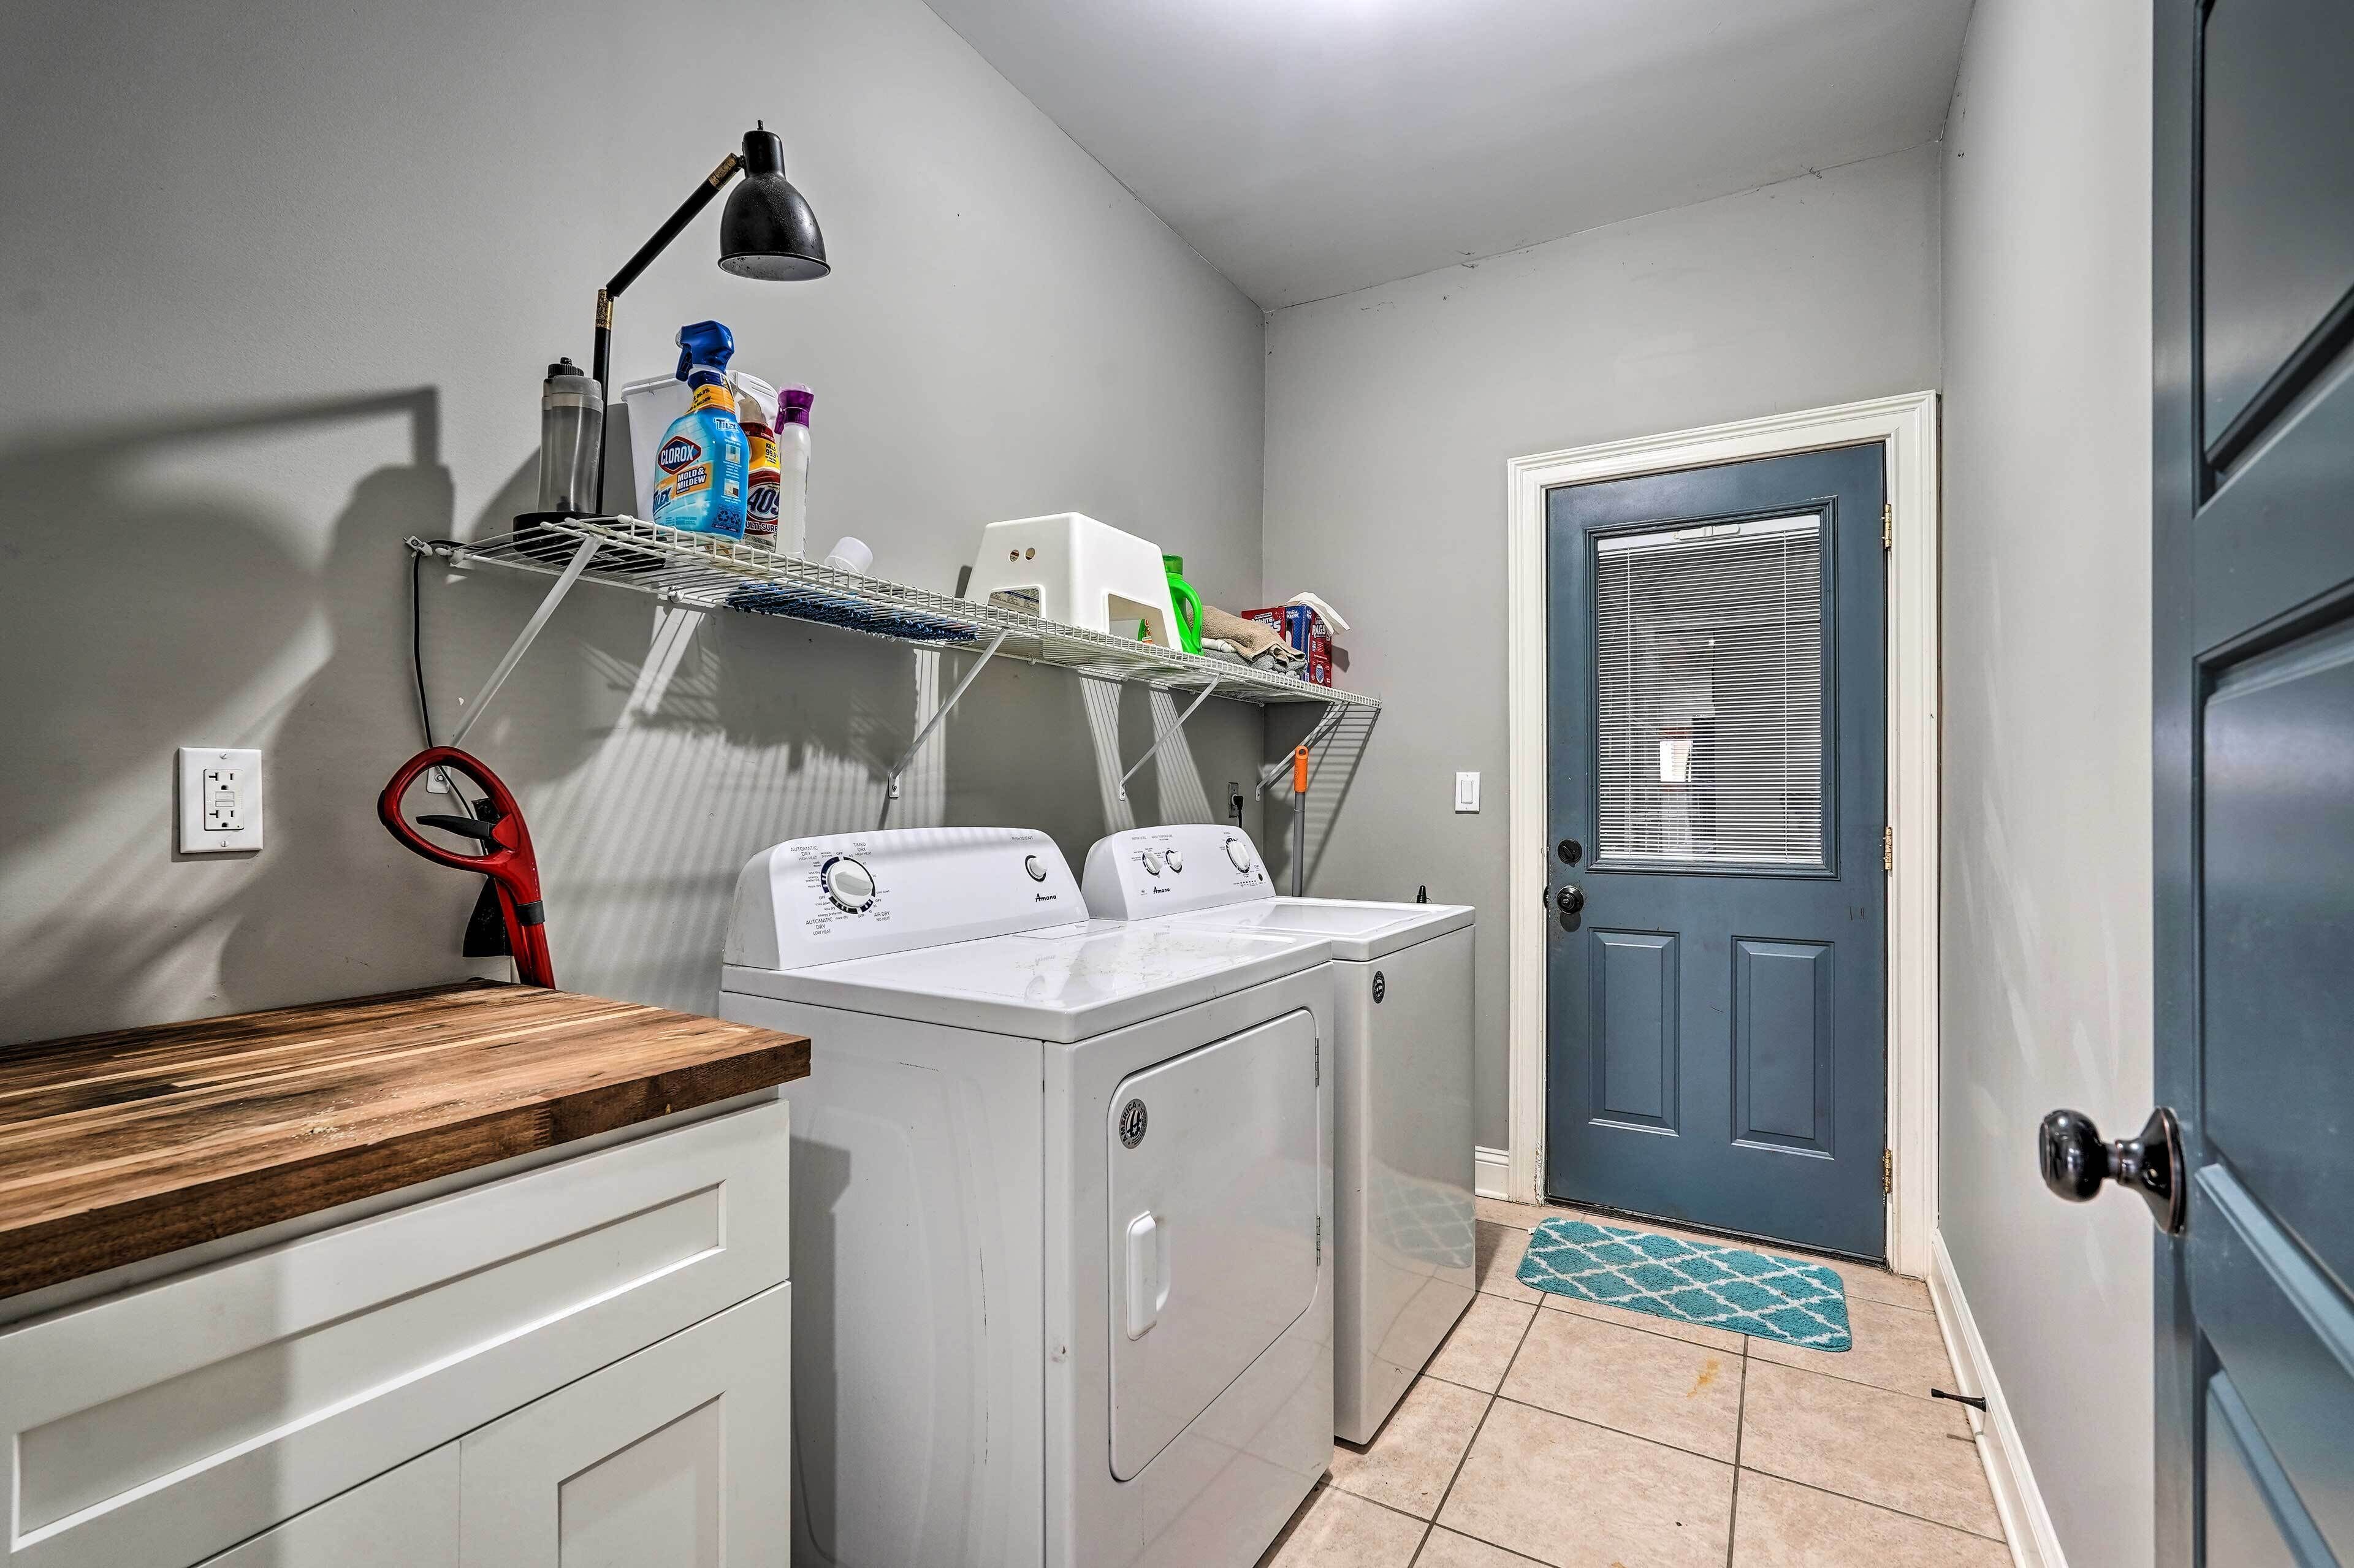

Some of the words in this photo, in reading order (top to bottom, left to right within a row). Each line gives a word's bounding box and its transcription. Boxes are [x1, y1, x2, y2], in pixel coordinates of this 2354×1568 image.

[660, 444, 695, 465] CLOROX
[677, 469, 698, 482] MOLD
[698, 467, 705, 476] &
[677, 475, 706, 490] MILDEW
[1312, 625, 1326, 638] RAGS
[1035, 893, 1057, 902] Amana
[1121, 1101, 1137, 1142] AMERICA
